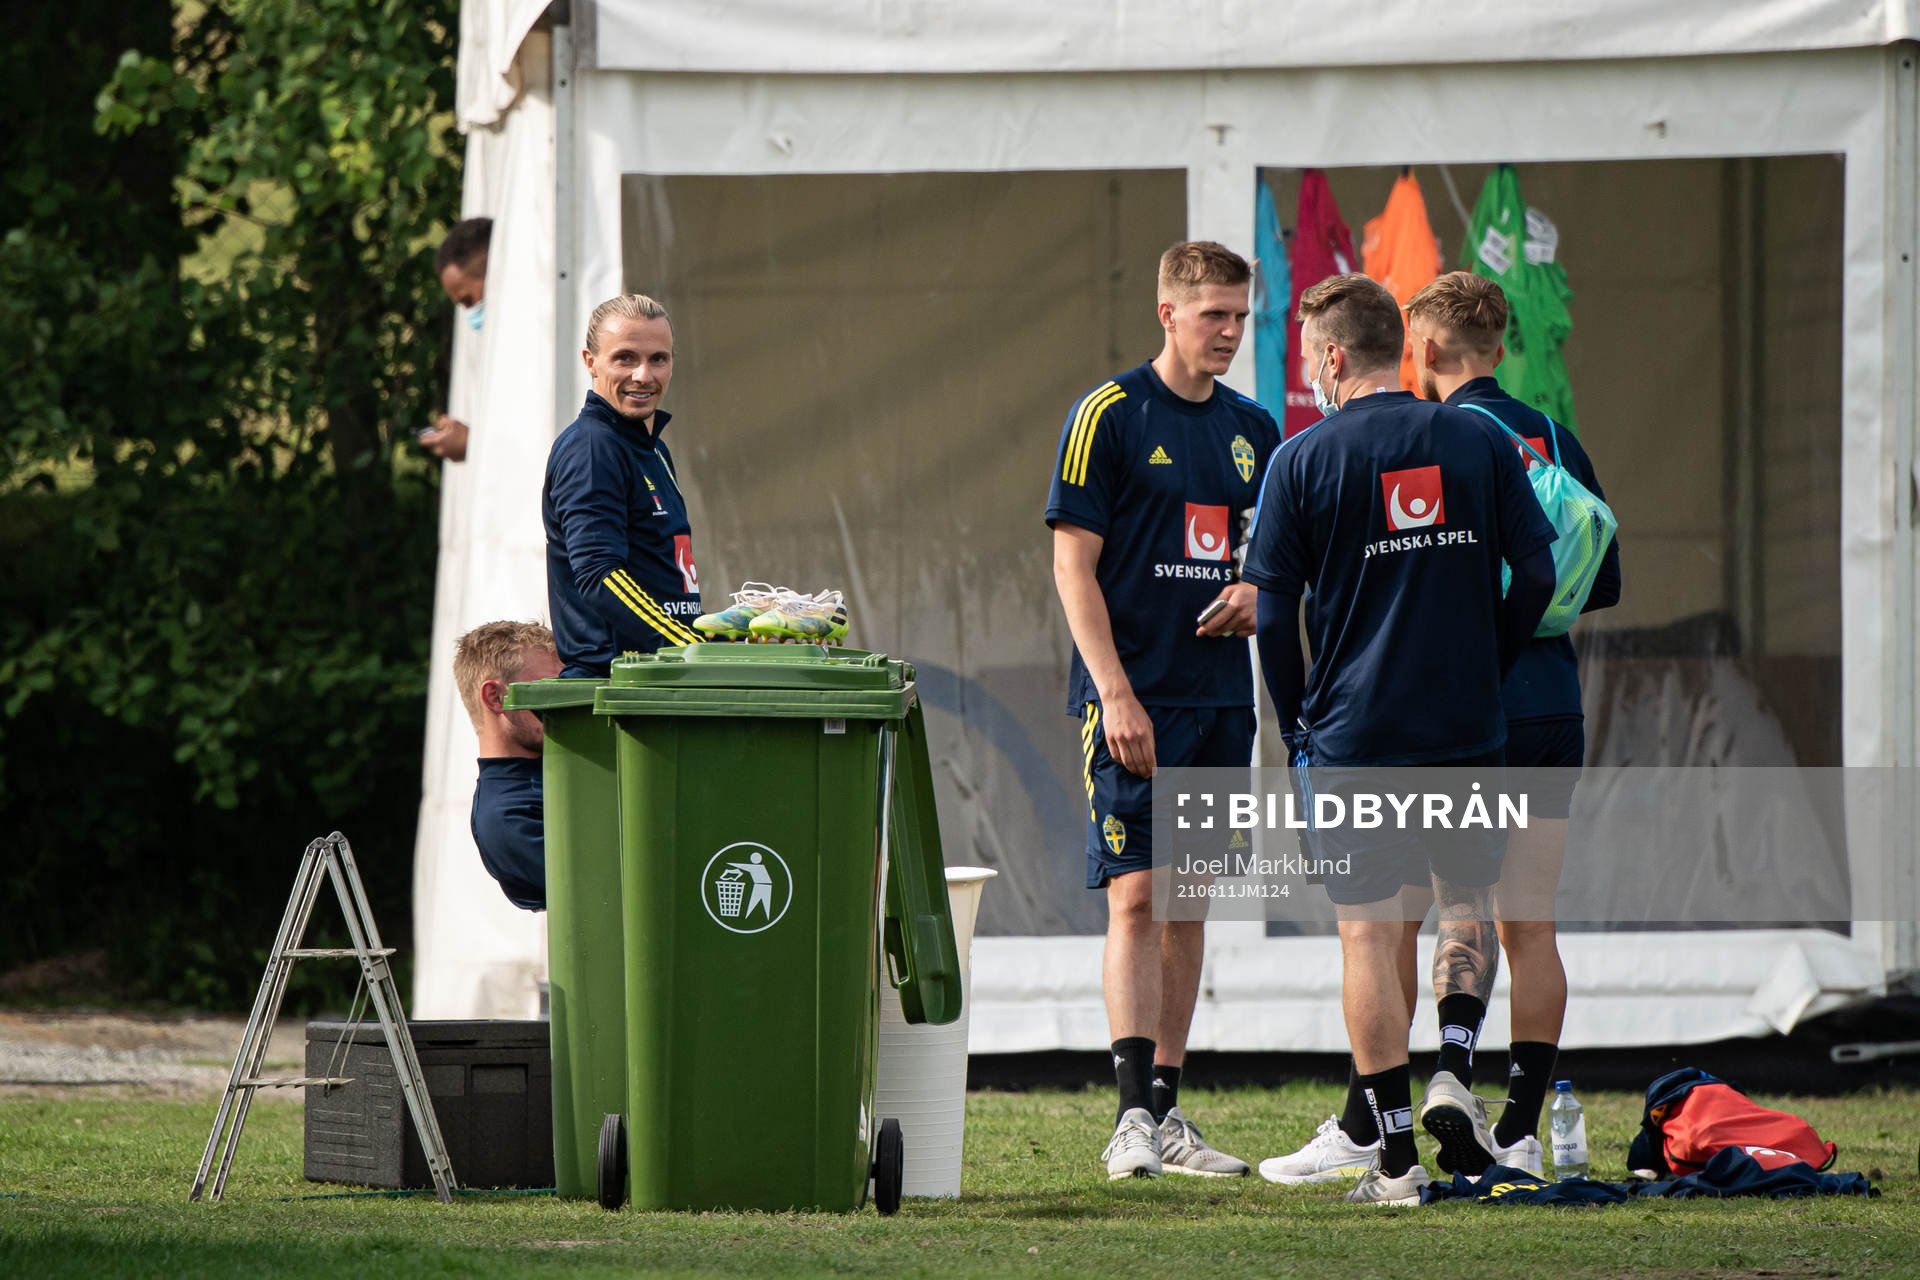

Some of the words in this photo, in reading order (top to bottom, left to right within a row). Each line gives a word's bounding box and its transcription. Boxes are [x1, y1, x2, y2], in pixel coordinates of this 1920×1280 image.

[1364, 533, 1433, 559] SVENSKA
[1437, 530, 1478, 546] SPEL
[1154, 563, 1221, 581] SVENSKA
